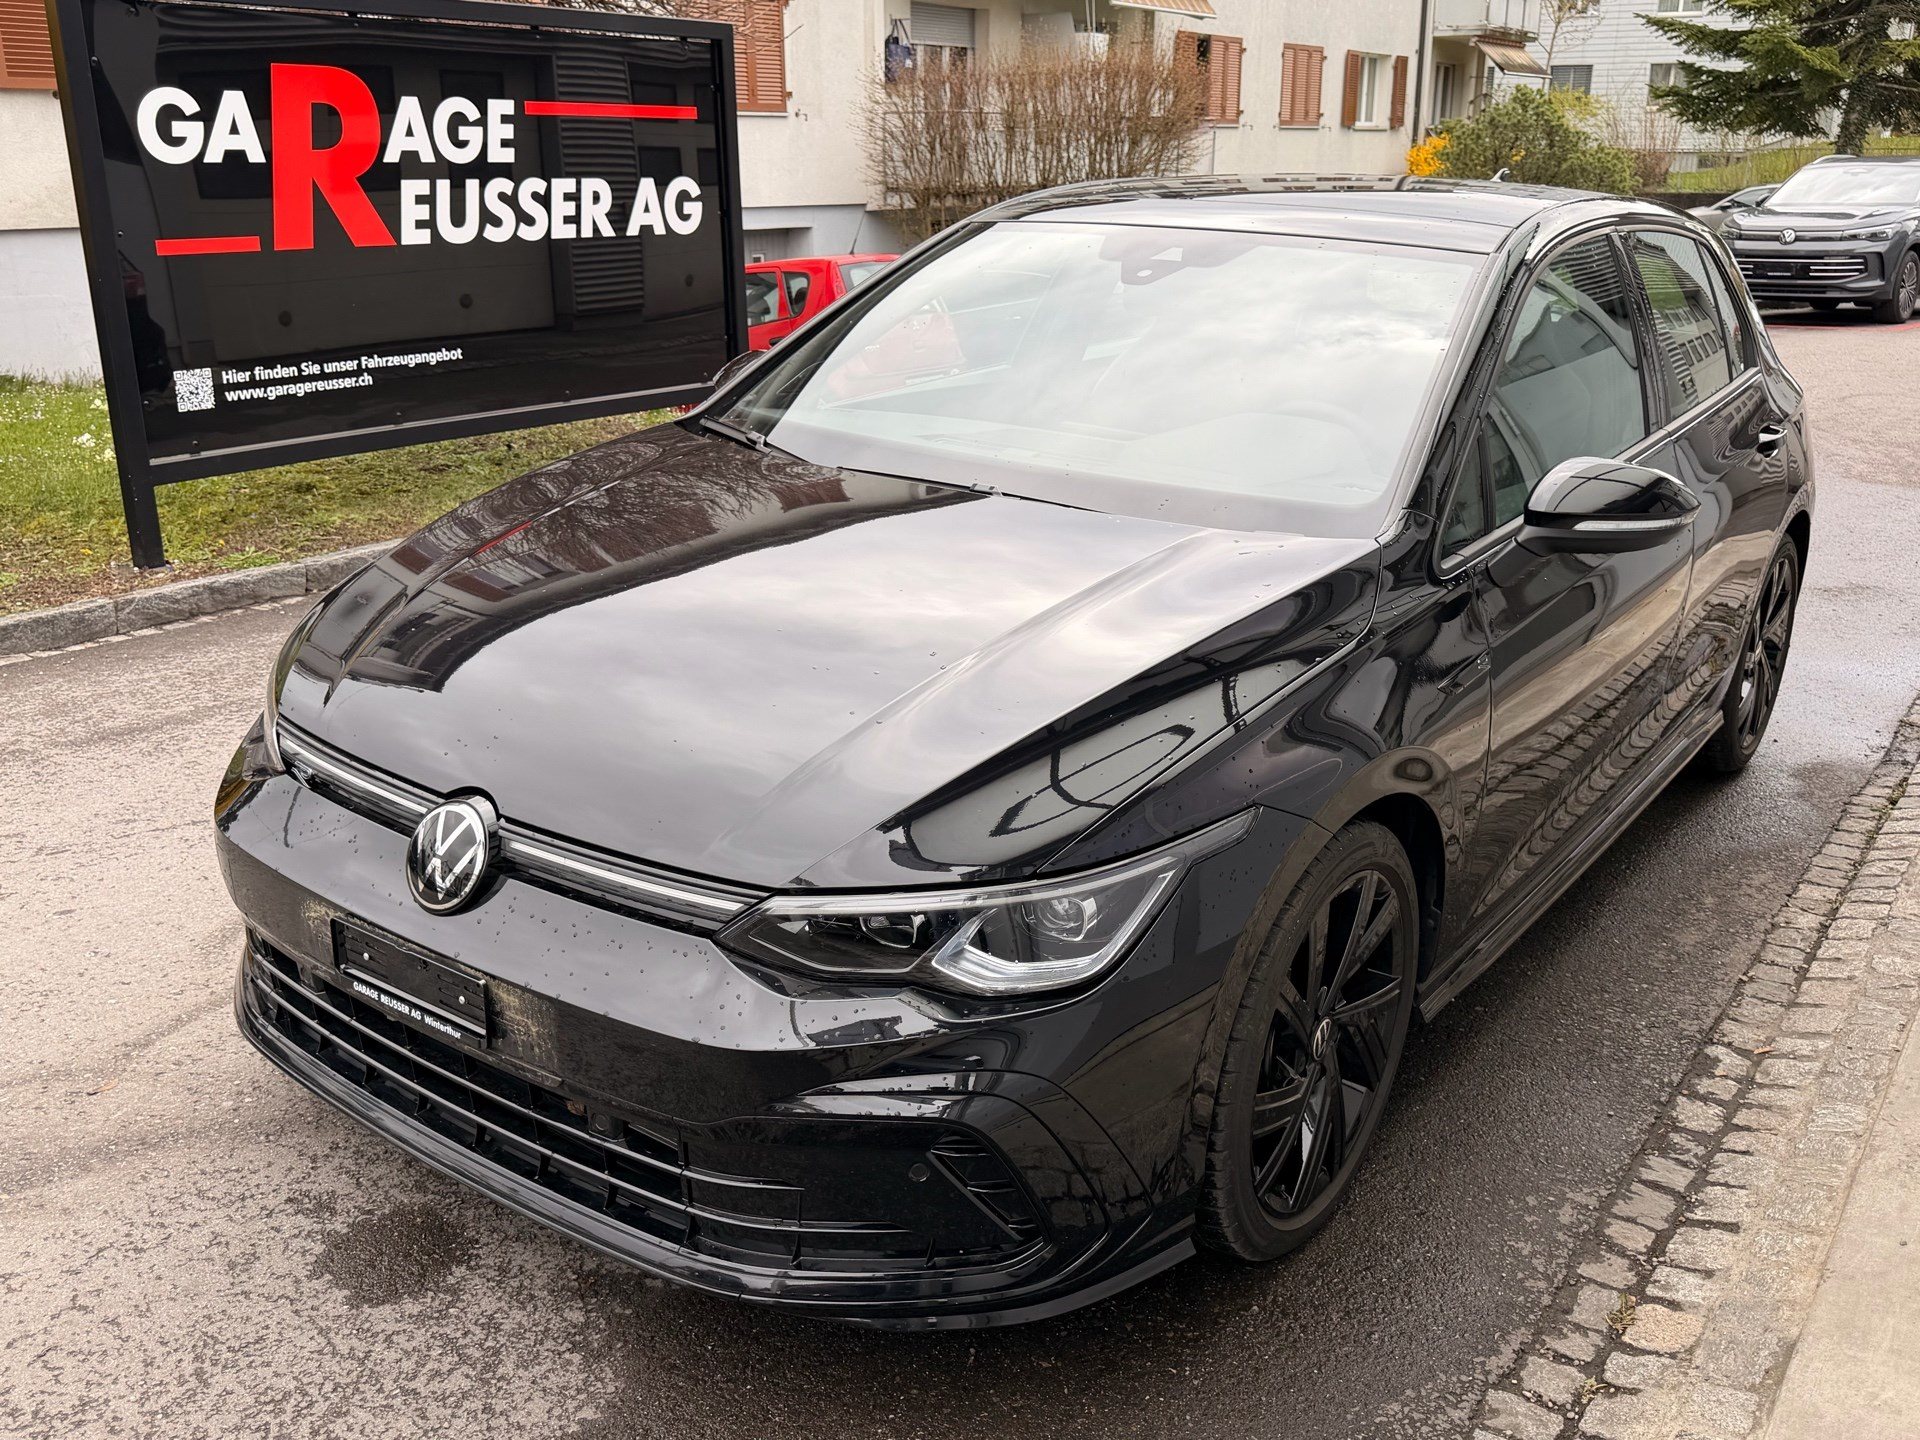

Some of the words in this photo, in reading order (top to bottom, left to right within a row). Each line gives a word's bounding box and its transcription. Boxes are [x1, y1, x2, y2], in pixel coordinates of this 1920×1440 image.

[137, 63, 516, 250] GARAGE
[626, 177, 703, 236] AG
[222, 369, 252, 385] Hier
[254, 365, 299, 381] finden
[301, 361, 321, 376] Sie
[324, 360, 359, 374] unser
[361, 347, 464, 370] Fahrzeugangebot
[225, 372, 374, 402] www.garagereusser.ch
[353, 981, 379, 1001] GARAGE
[381, 994, 410, 1016] REUSSER
[411, 1008, 422, 1021] AG
[424, 1014, 462, 1040] Winterthur
